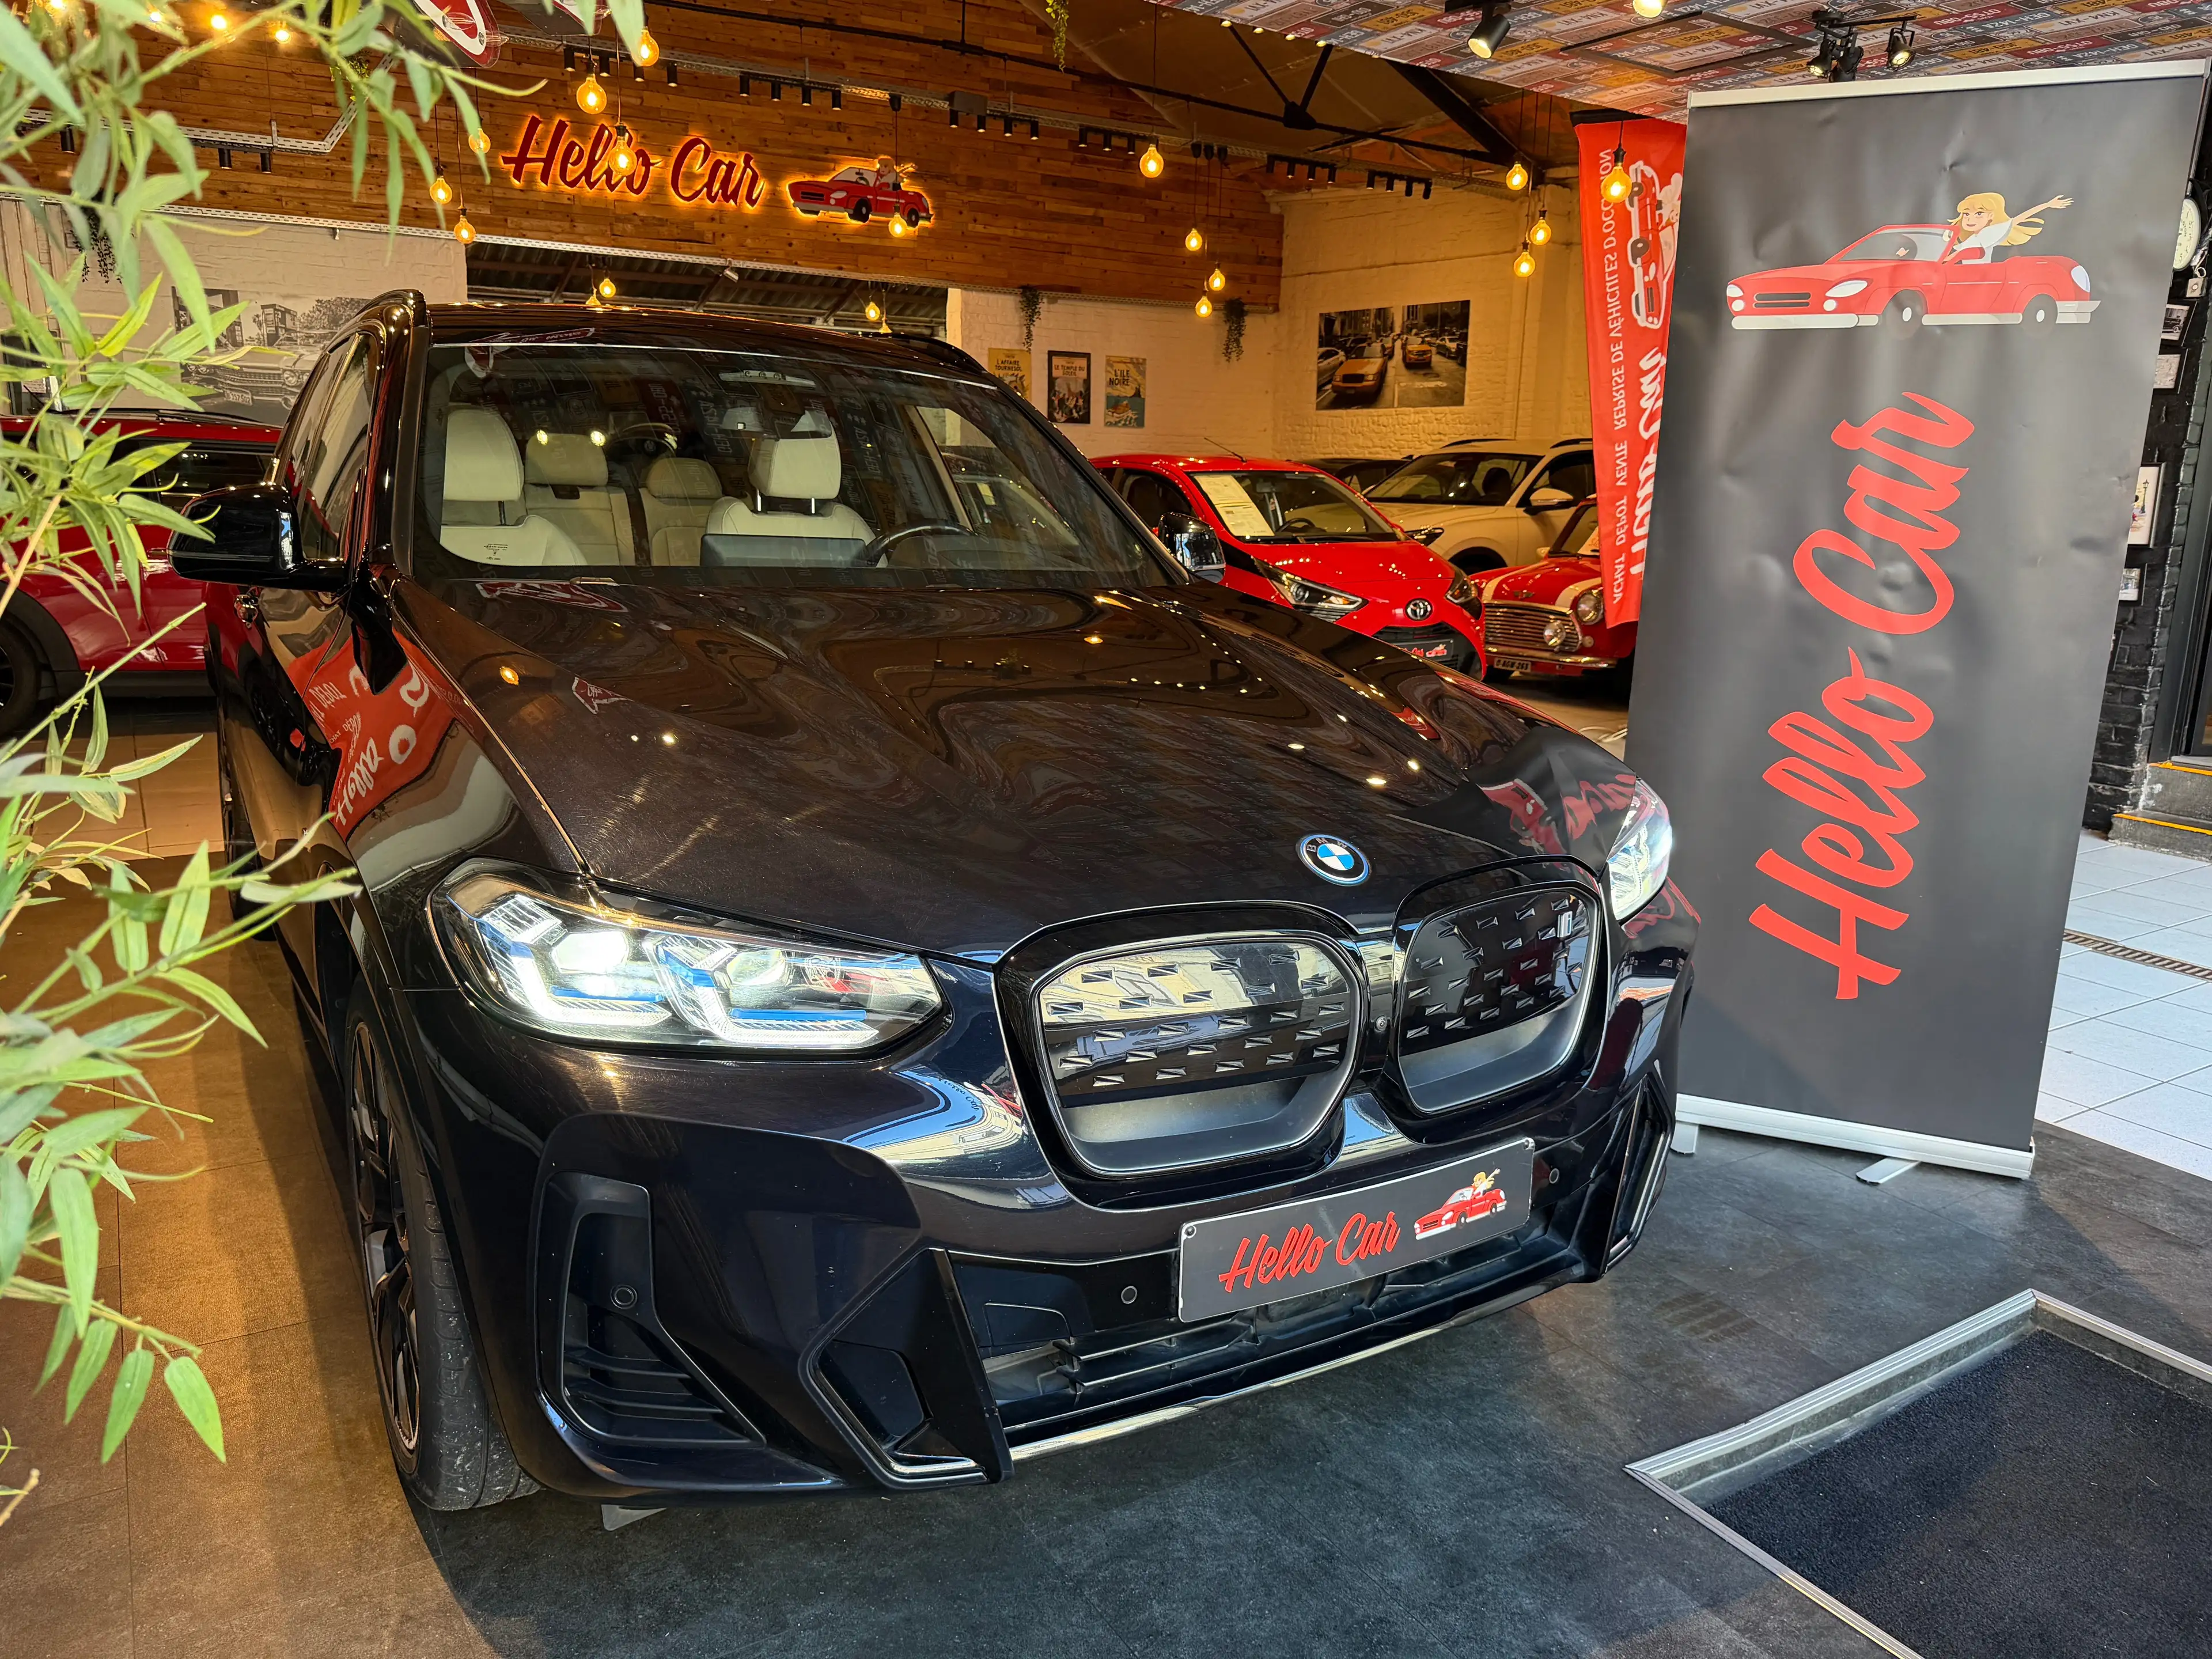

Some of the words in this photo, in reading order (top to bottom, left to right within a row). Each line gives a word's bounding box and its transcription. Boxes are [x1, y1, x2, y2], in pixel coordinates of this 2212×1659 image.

[501, 116, 664, 195] Hello
[670, 137, 764, 208] Car
[1793, 392, 1975, 635] Car
[1749, 646, 1934, 999] Hello
[1219, 1223, 1332, 1293] Hello
[1335, 1210, 1401, 1266] Car
